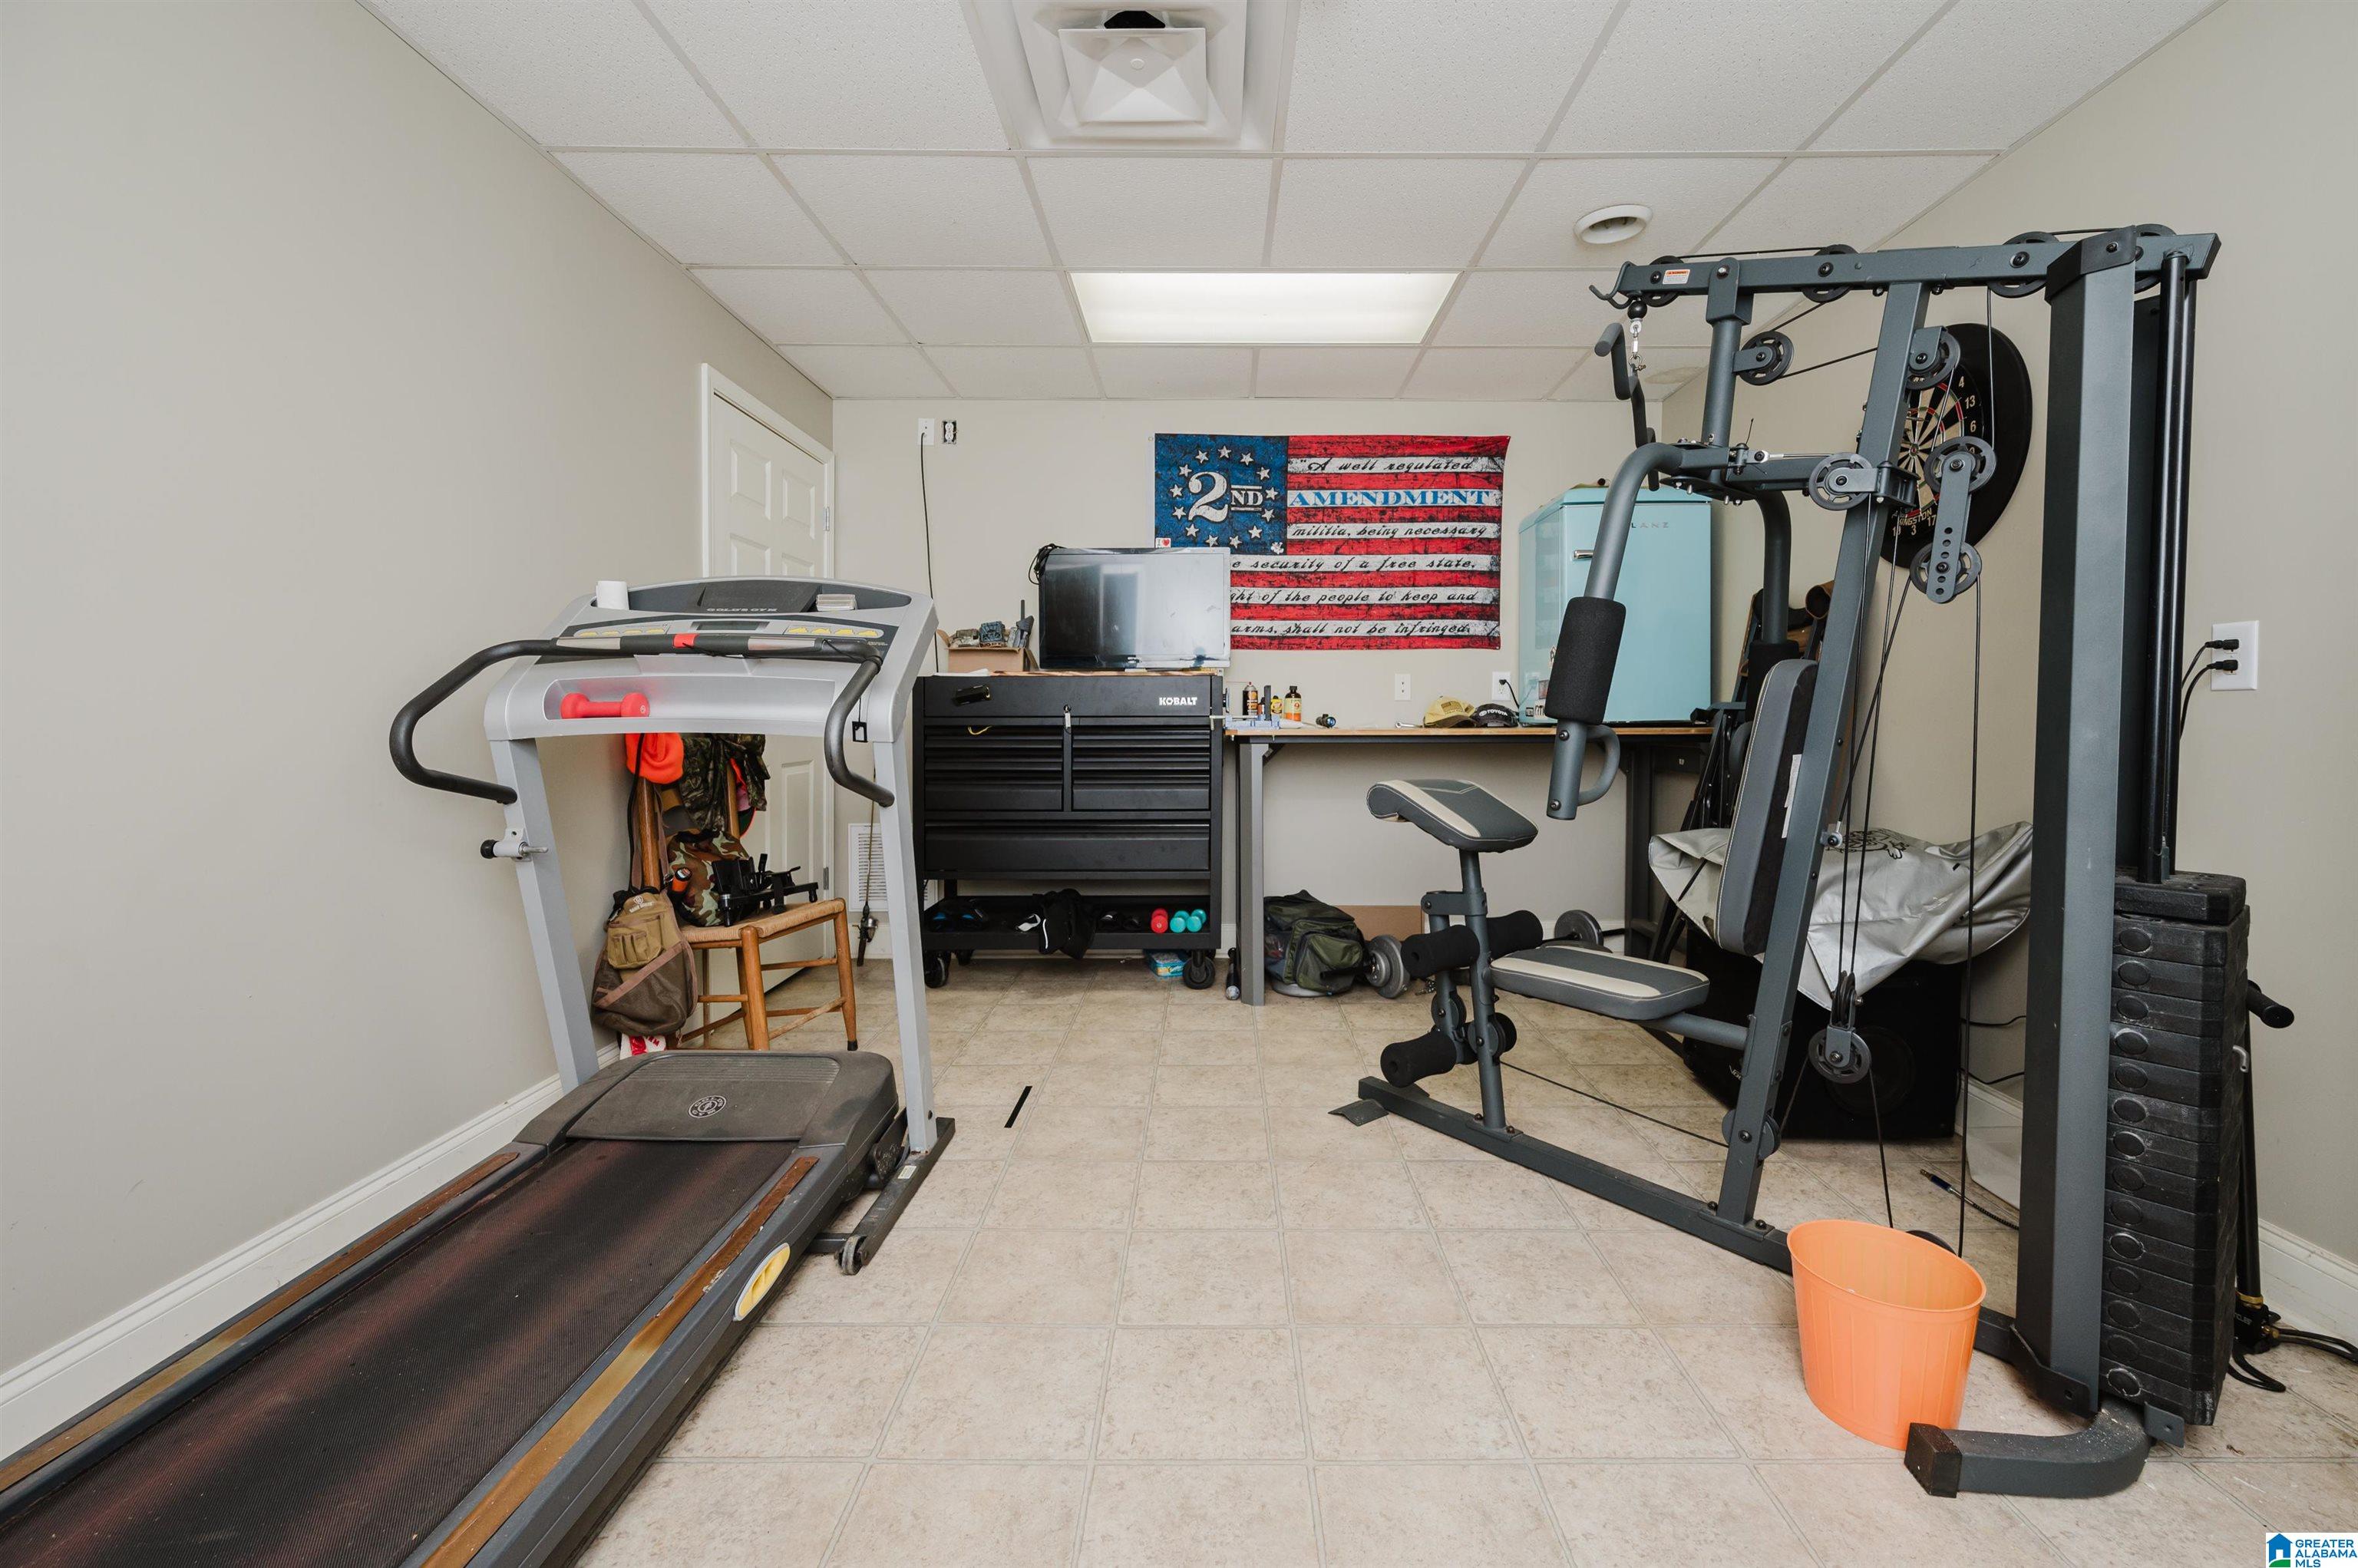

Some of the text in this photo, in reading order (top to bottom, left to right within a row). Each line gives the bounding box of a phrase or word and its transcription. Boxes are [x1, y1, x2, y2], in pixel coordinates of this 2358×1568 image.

[1965, 395, 1976, 409] 13
[1970, 421, 1977, 432] 6
[1339, 460, 1378, 470] well
[1383, 459, 1473, 472] regulated
[1290, 490, 1490, 506] AMENDMENT
[1356, 525, 1399, 538] being
[1404, 525, 1488, 538] necessary
[1911, 524, 1917, 536] 3
[1250, 558, 1325, 572] security
[1334, 556, 1356, 571] of
[1376, 556, 1417, 571] free
[1230, 589, 1479, 604] ght of the people to keep and
[1283, 622, 1329, 635] shall
[1334, 623, 1361, 634] not
[1367, 623, 1387, 634] be
[1158, 697, 1197, 706] KOBALT
